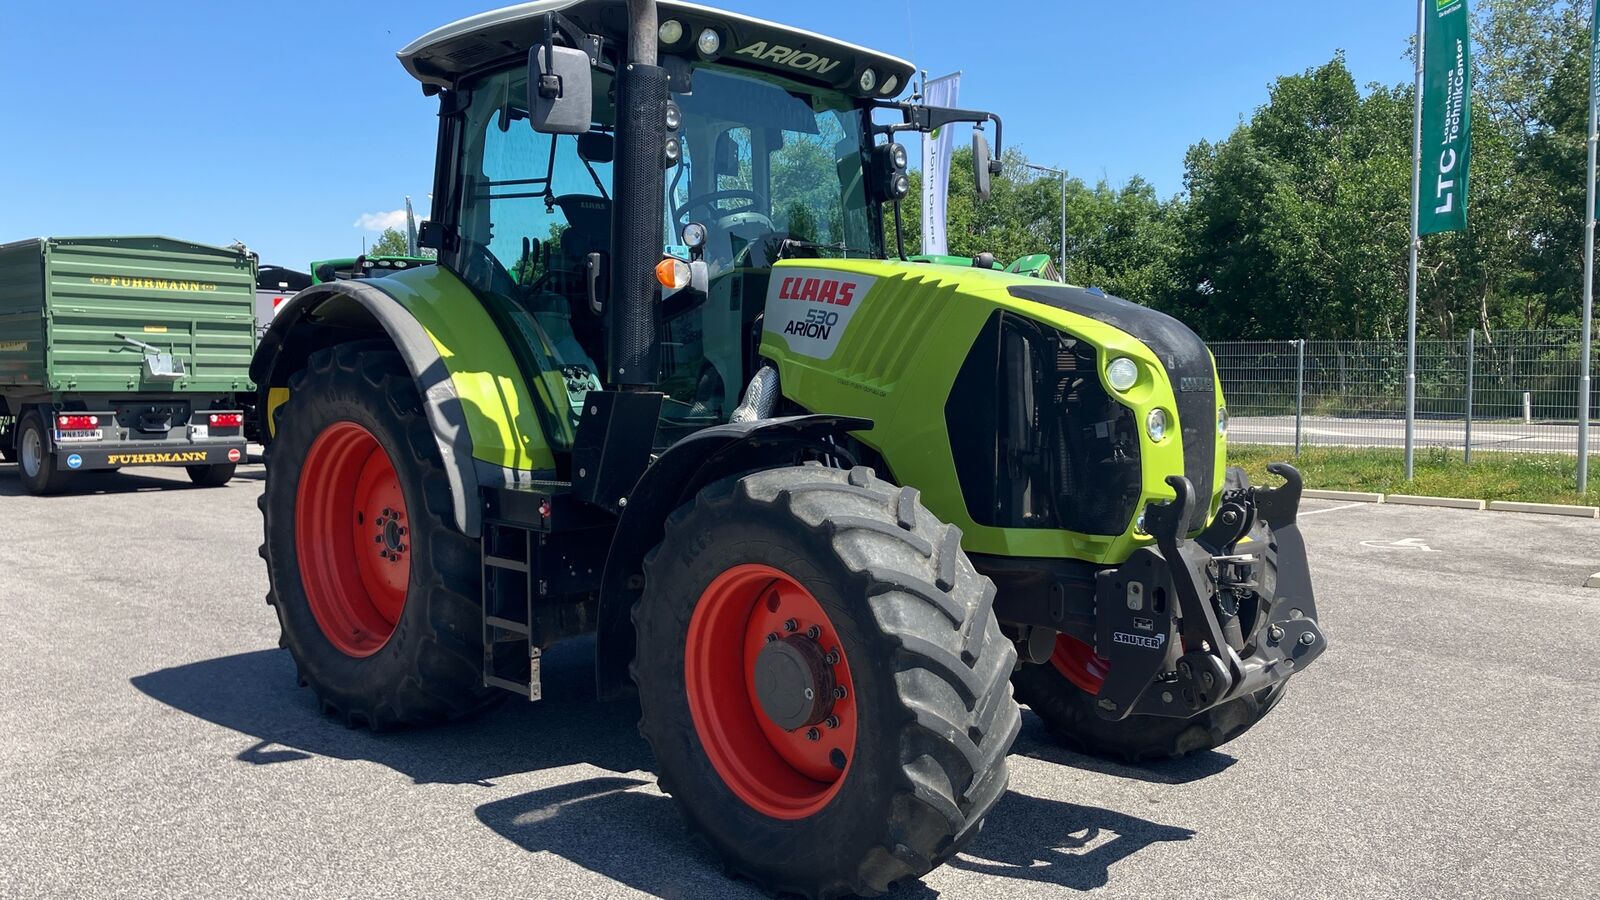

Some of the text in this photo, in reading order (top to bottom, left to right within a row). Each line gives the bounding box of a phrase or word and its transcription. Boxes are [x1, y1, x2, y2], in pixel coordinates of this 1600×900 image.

[735, 41, 840, 74] ARION
[1448, 38, 1463, 142] TechnikCenter
[929, 147, 937, 190] JOHN
[1435, 148, 1456, 214] LTC
[110, 277, 199, 292] FUHRMANN
[779, 277, 857, 307] CLAAS
[784, 320, 831, 340] ARION
[805, 309, 839, 327] 530
[108, 452, 207, 464] FUHRMANN
[1113, 632, 1159, 649] SAUTER
